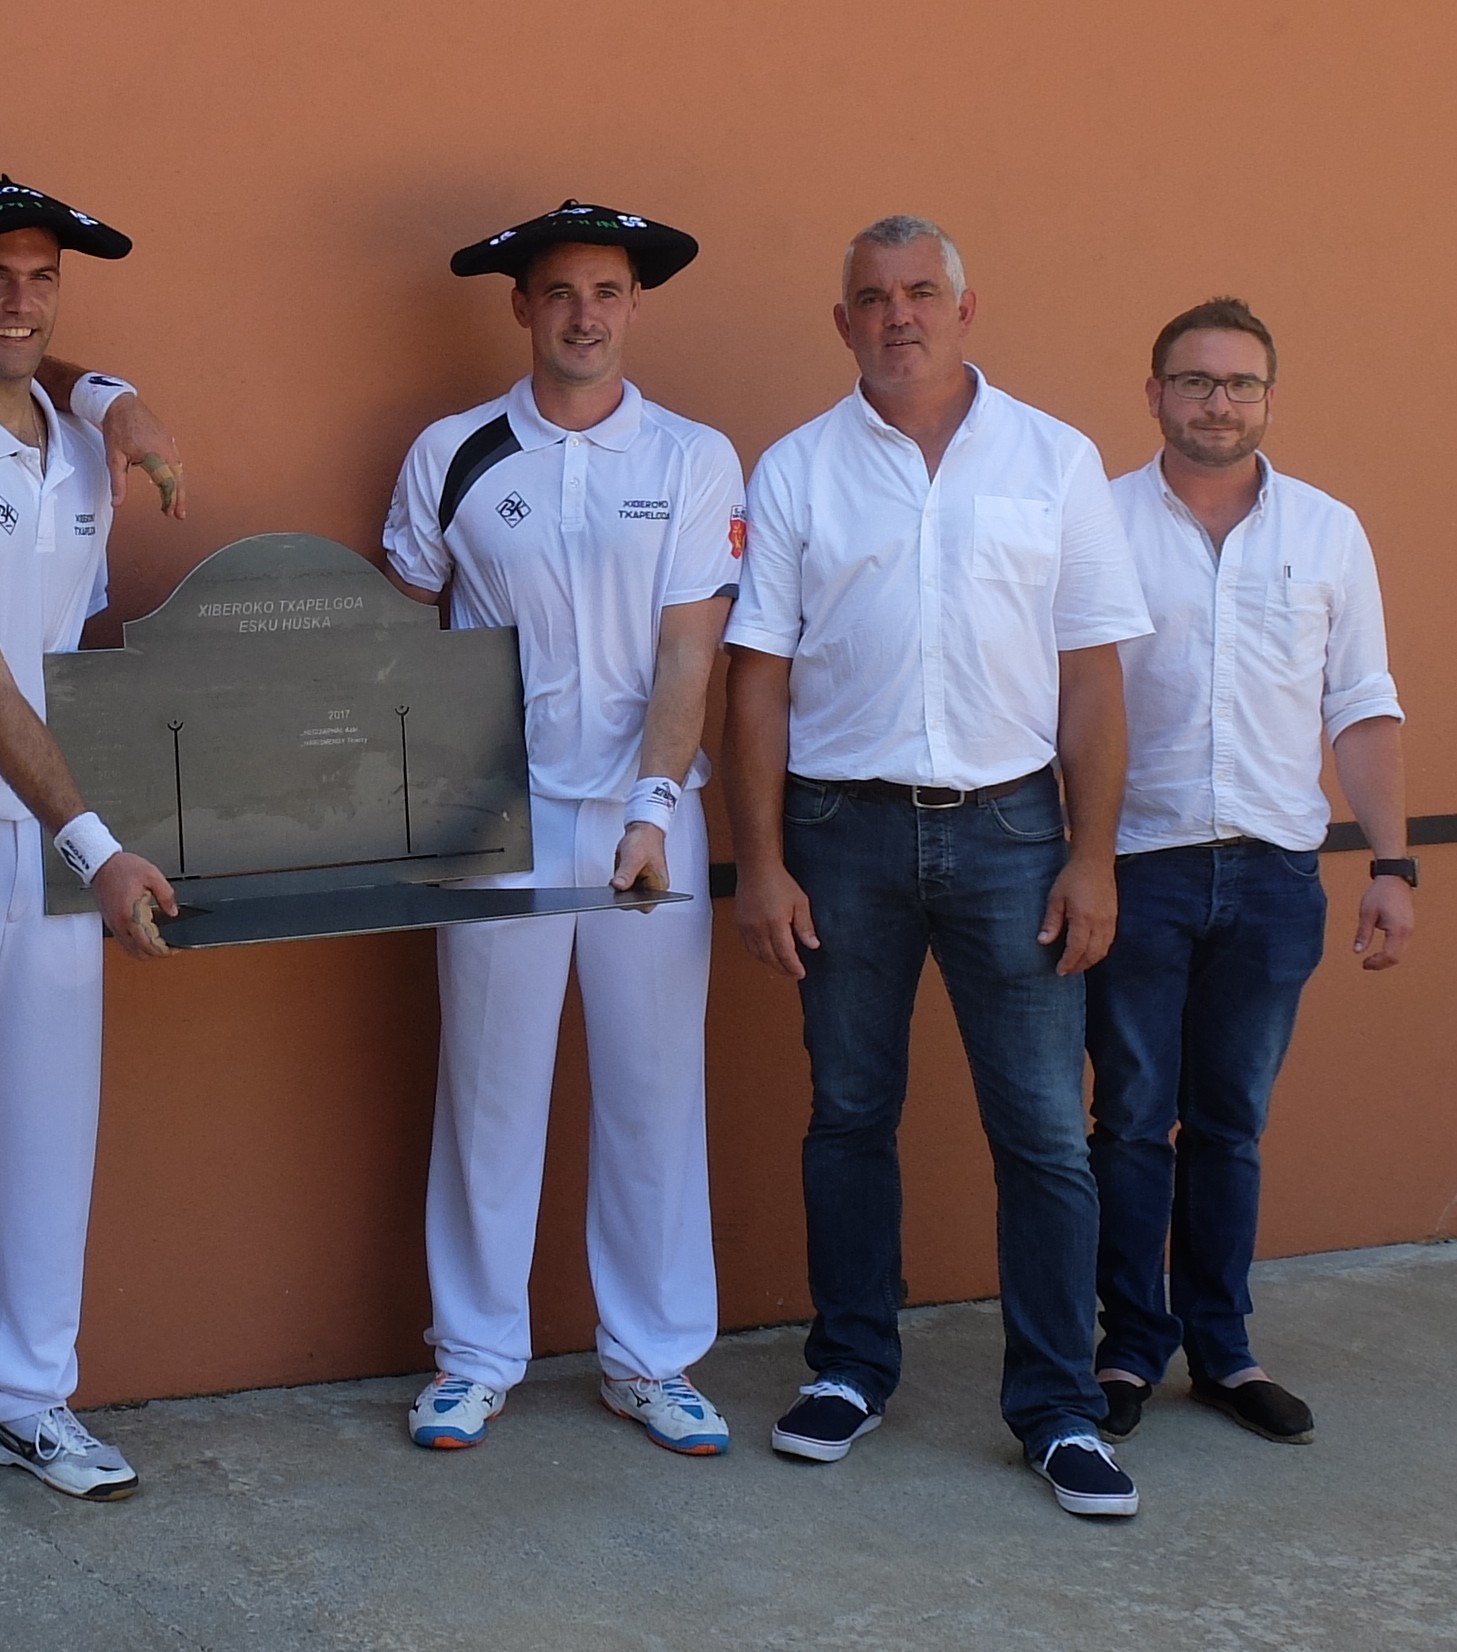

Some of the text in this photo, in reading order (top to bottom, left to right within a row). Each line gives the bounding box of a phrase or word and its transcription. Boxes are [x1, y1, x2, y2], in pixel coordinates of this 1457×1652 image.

[198, 596, 364, 618] XIBEROKO TXAPELGOA
[239, 615, 331, 633] ESKU HUSKA
[327, 708, 351, 720] 2017
